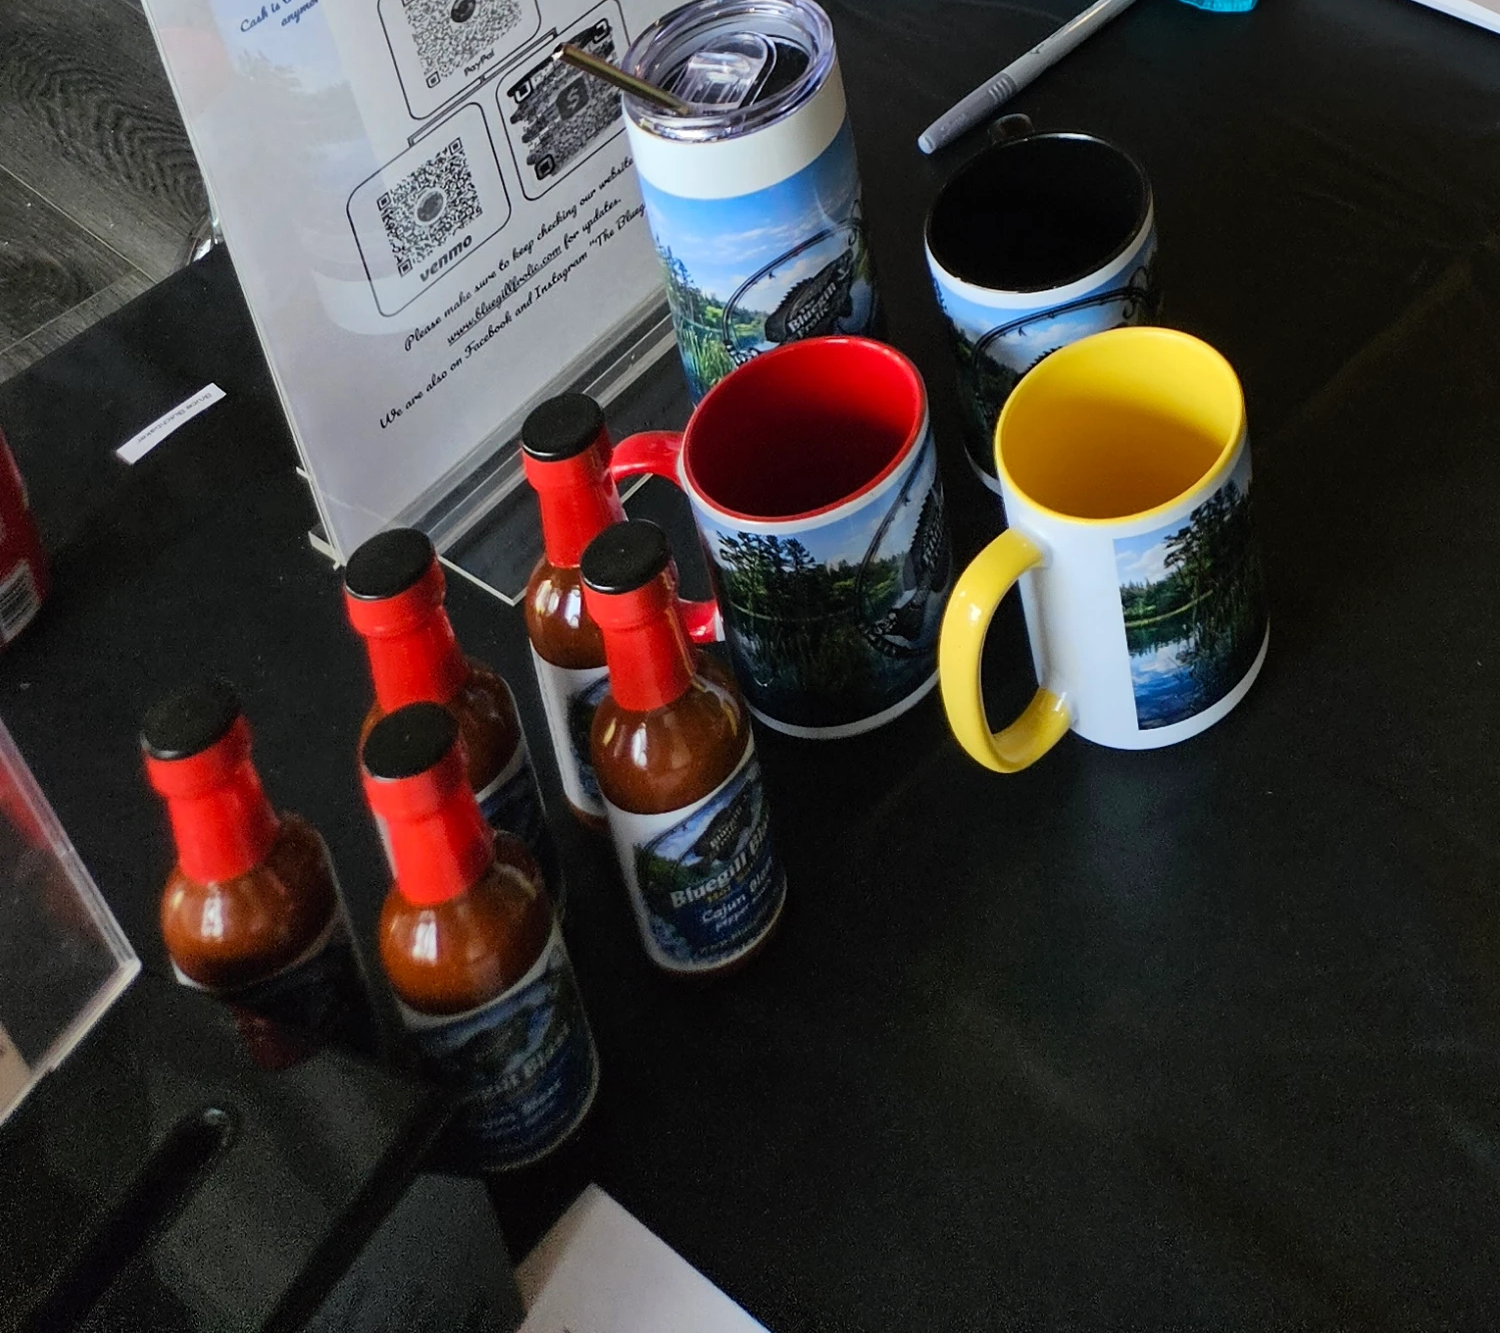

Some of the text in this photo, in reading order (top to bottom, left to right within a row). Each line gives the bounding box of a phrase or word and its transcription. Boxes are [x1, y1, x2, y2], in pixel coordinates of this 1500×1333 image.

[240, 6, 268, 32] Cash
[270, 2, 281, 14] is
[464, 49, 495, 76] PayPal
[405, 156, 634, 352] Please make sure to keep checking our website
[420, 235, 472, 282] venmo
[447, 198, 622, 346] www.bluegillfrolic.com for updates.
[379, 407, 403, 430] We
[405, 391, 423, 409] are
[425, 370, 448, 393] also
[449, 357, 463, 372] on
[464, 311, 512, 358] Facebook
[514, 290, 533, 317] and
[535, 252, 587, 300] Instagram
[615, 203, 646, 231] Blueg
[669, 851, 748, 909] Bluegill
